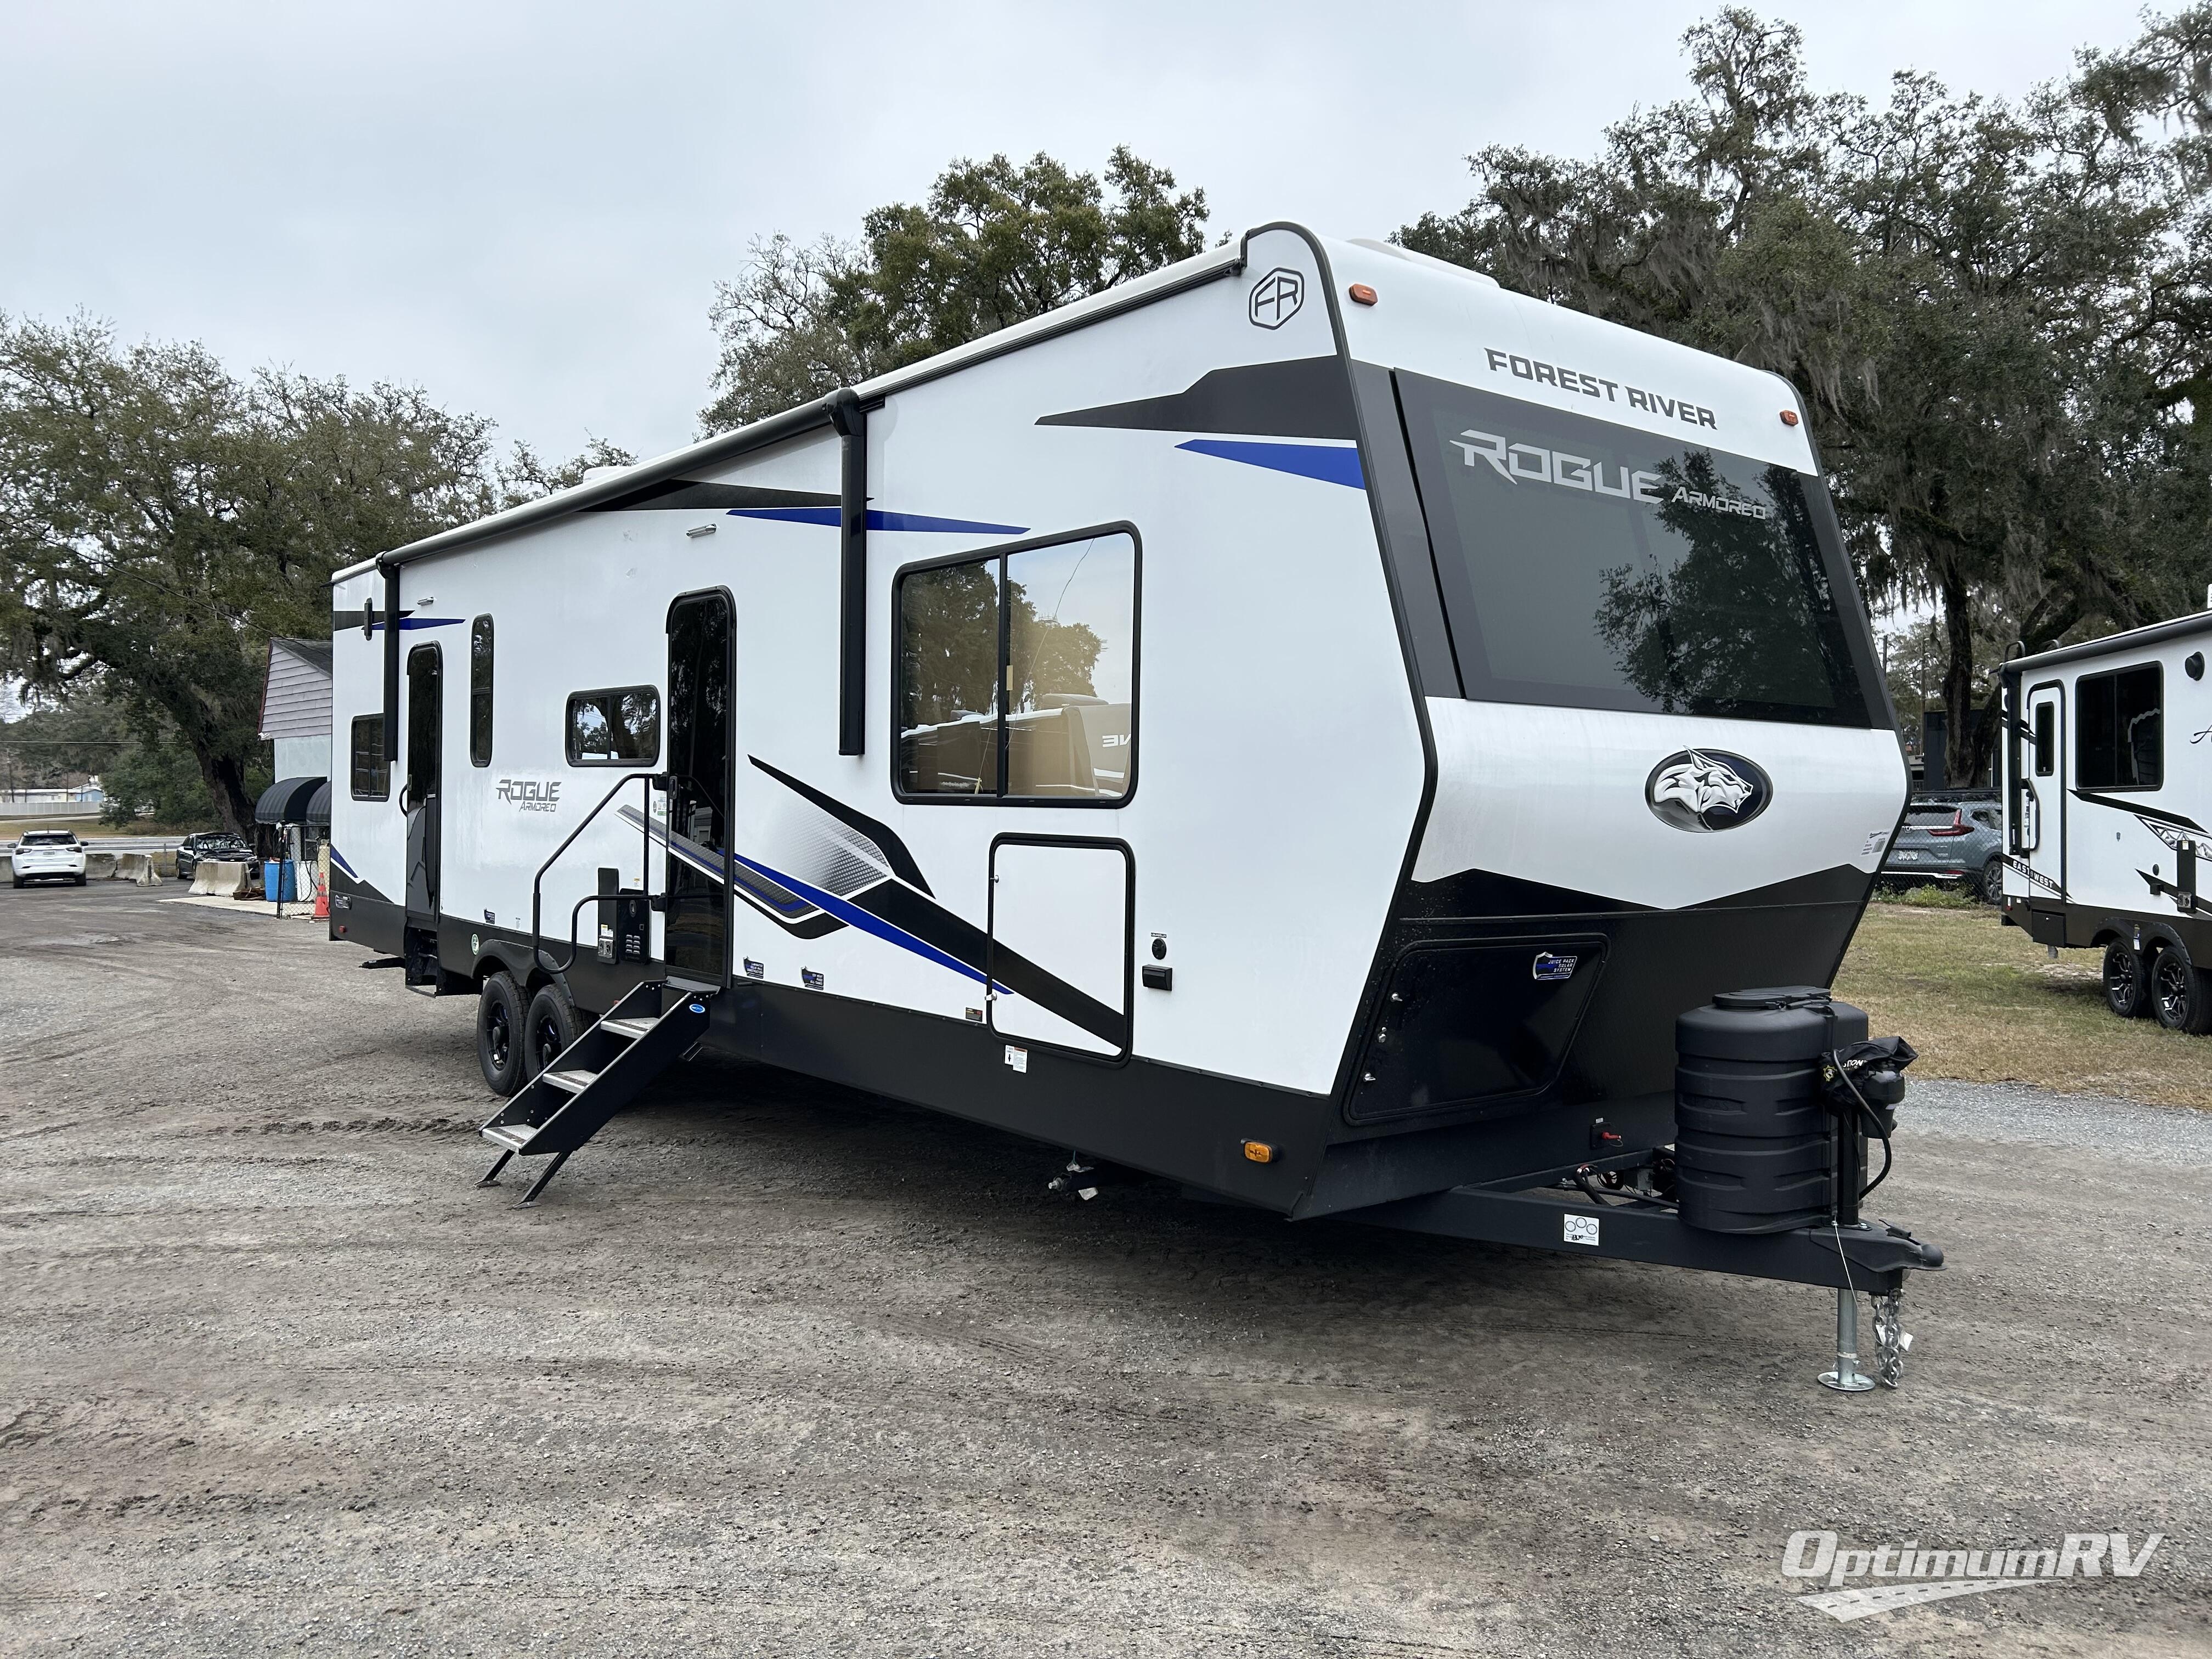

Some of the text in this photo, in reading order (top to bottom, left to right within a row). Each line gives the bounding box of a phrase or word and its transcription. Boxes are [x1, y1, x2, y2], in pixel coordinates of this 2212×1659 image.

[1483, 347, 1718, 431] FOREST RIVER
[1449, 429, 1766, 520] ROGUE ARMORED
[495, 779, 562, 805] ROGUE
[519, 800, 557, 812] ARMORED
[2034, 872, 2054, 888] WEST
